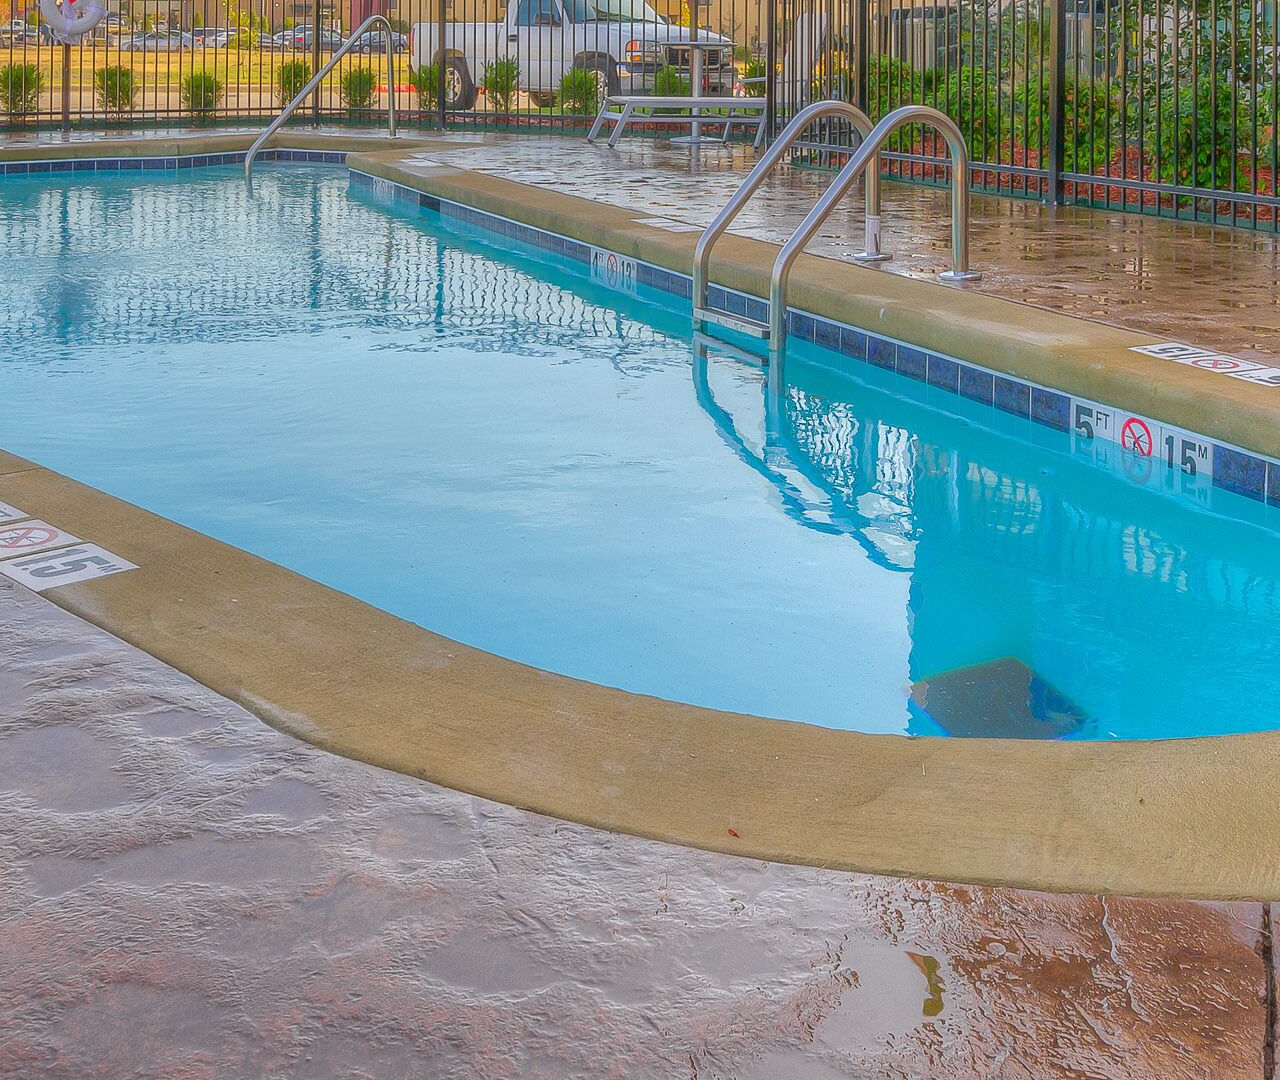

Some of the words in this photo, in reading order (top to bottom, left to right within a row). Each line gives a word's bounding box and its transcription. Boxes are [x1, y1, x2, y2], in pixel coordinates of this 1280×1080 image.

[1075, 404, 1094, 440] 5
[1095, 410, 1110, 430] FT
[1198, 444, 1208, 460] M
